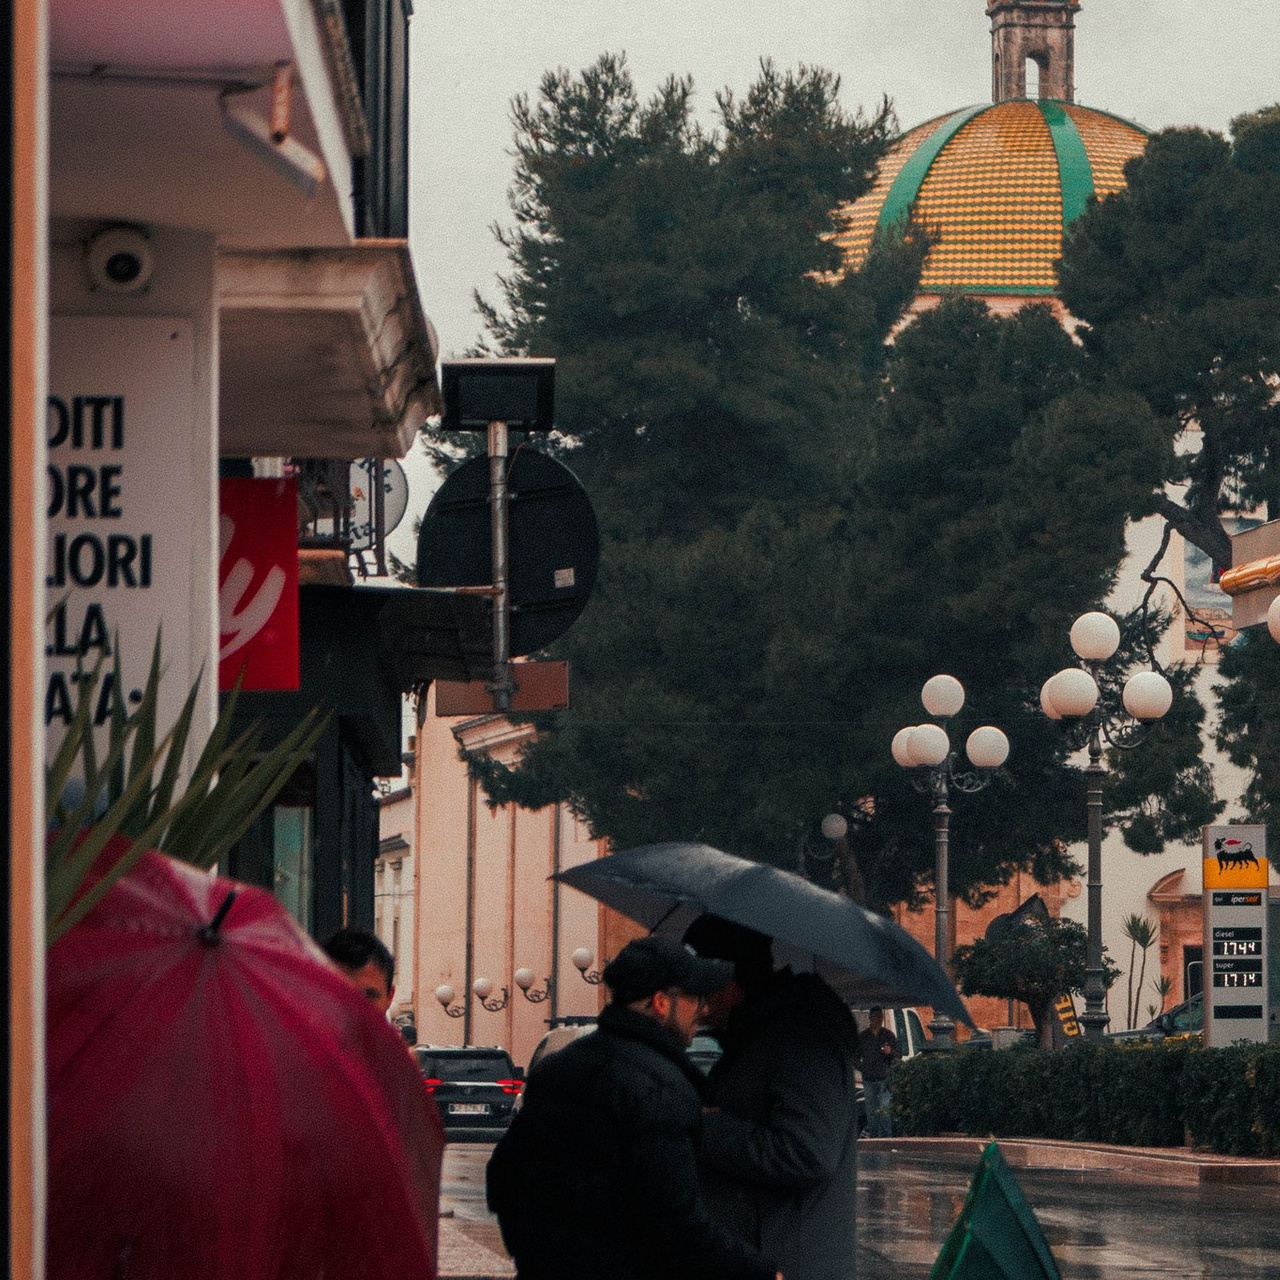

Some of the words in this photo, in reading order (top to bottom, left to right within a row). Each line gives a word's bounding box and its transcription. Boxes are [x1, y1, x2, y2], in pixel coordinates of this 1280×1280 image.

[46, 532, 153, 589] IORI
[45, 602, 112, 658] LA
[1230, 894, 1259, 904] iperself
[1215, 930, 1235, 938] diesel
